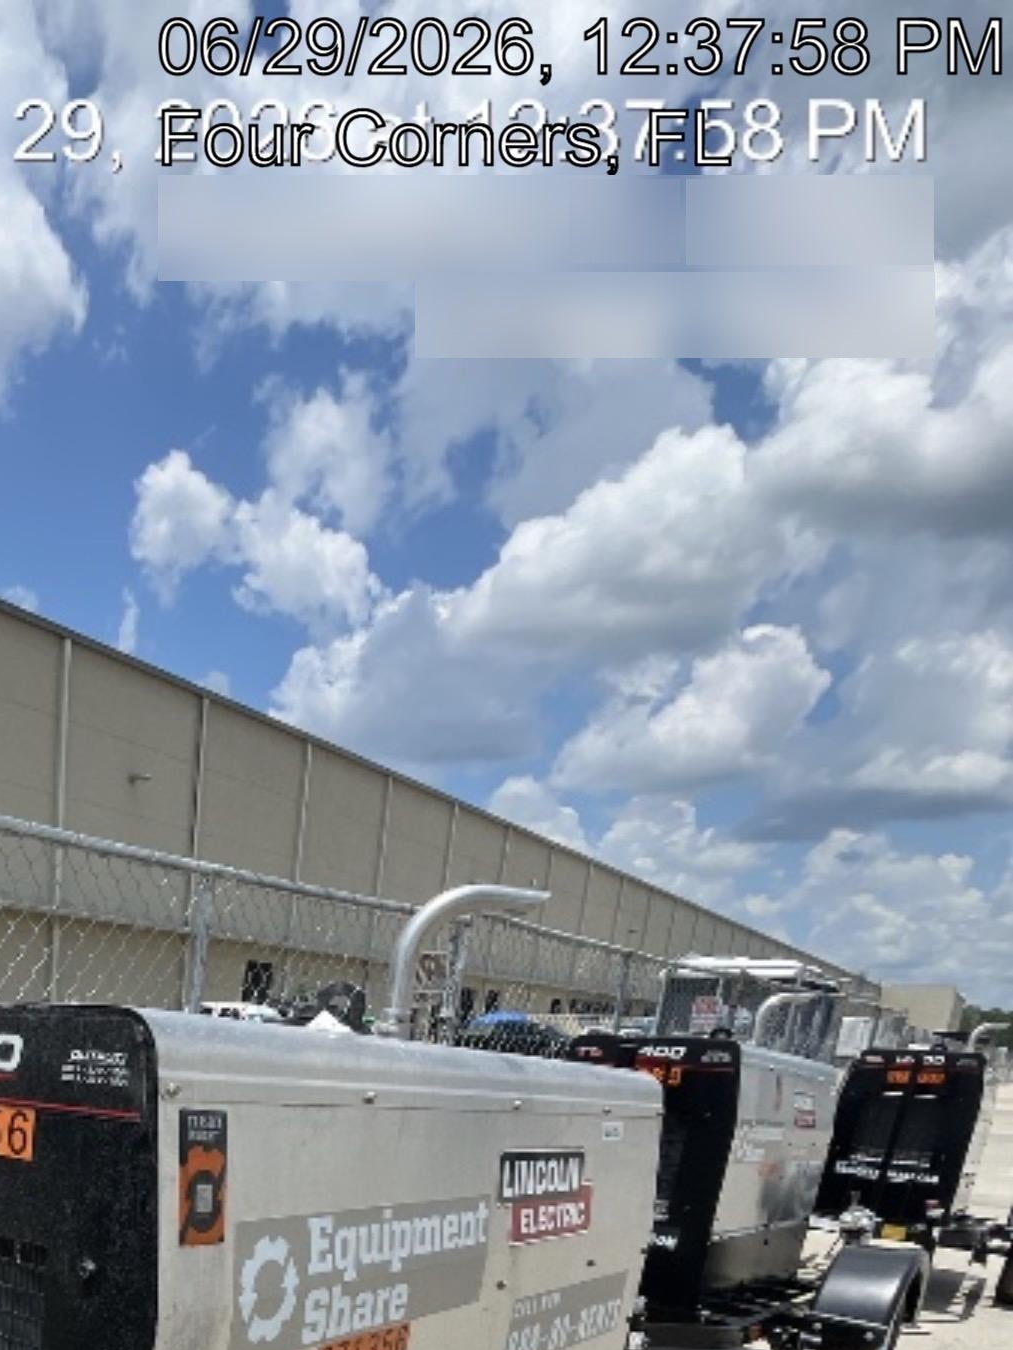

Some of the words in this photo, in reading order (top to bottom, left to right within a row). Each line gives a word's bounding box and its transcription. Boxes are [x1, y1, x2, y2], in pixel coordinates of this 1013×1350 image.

[502, 1157, 580, 1198] LINCOLN
[307, 1200, 489, 1282] Equipment
[520, 1202, 586, 1235] ELECTRIC
[301, 1283, 409, 1345] Share
